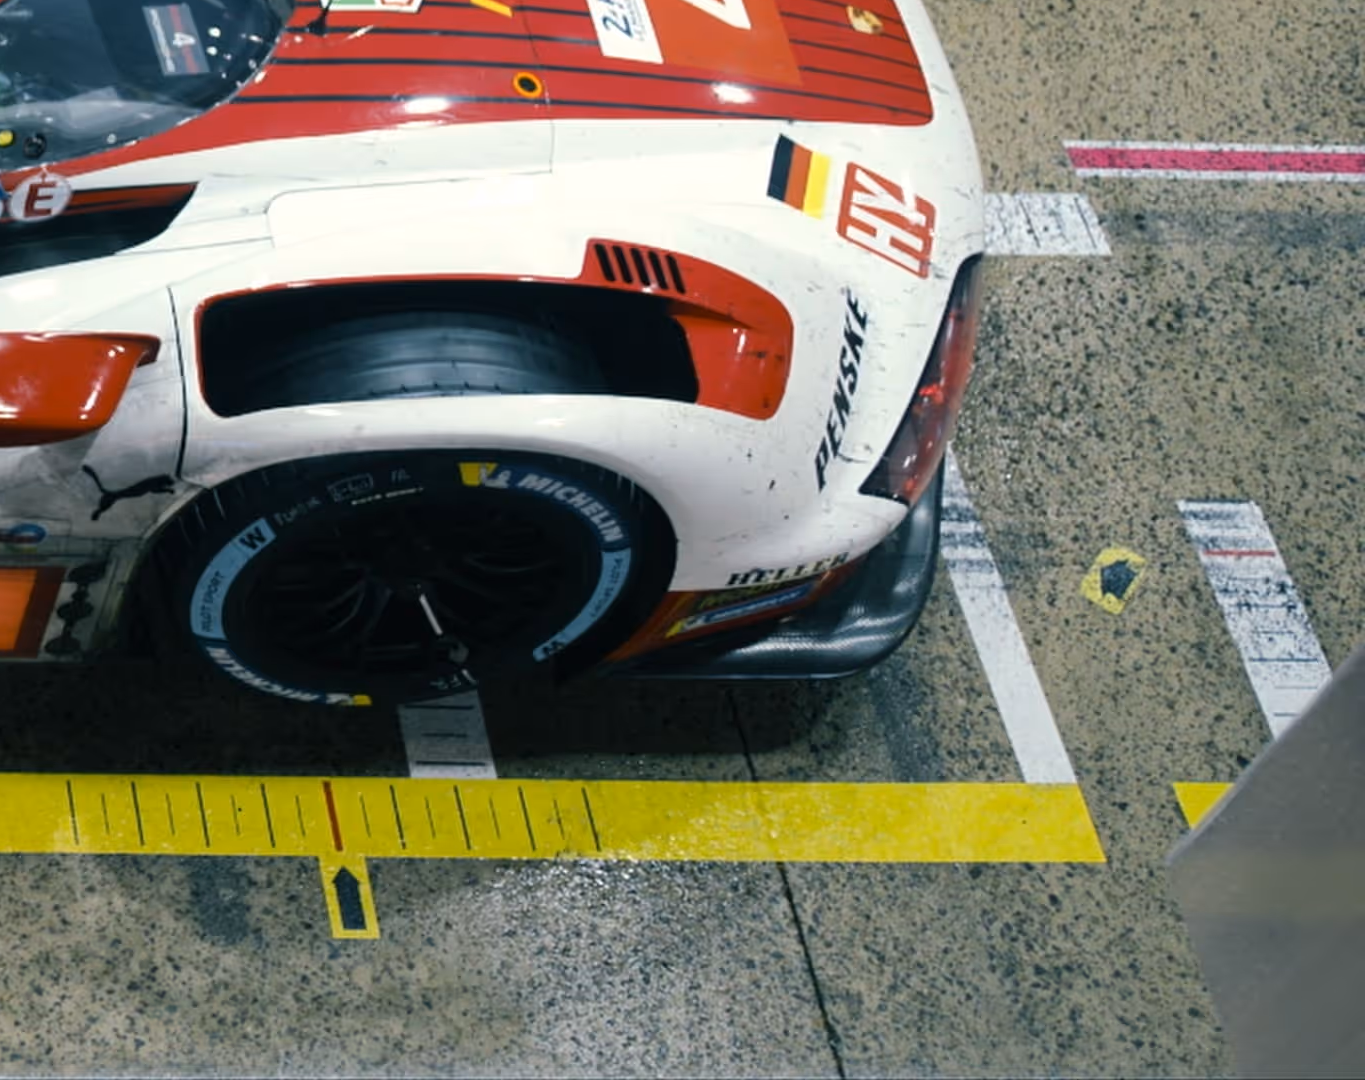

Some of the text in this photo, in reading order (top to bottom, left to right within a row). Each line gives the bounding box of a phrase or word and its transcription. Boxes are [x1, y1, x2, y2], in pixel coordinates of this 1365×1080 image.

[24, 182, 58, 216] E
[845, 167, 930, 275] HY
[815, 289, 870, 491] PENSKE
[517, 474, 623, 542] MICHELIN
